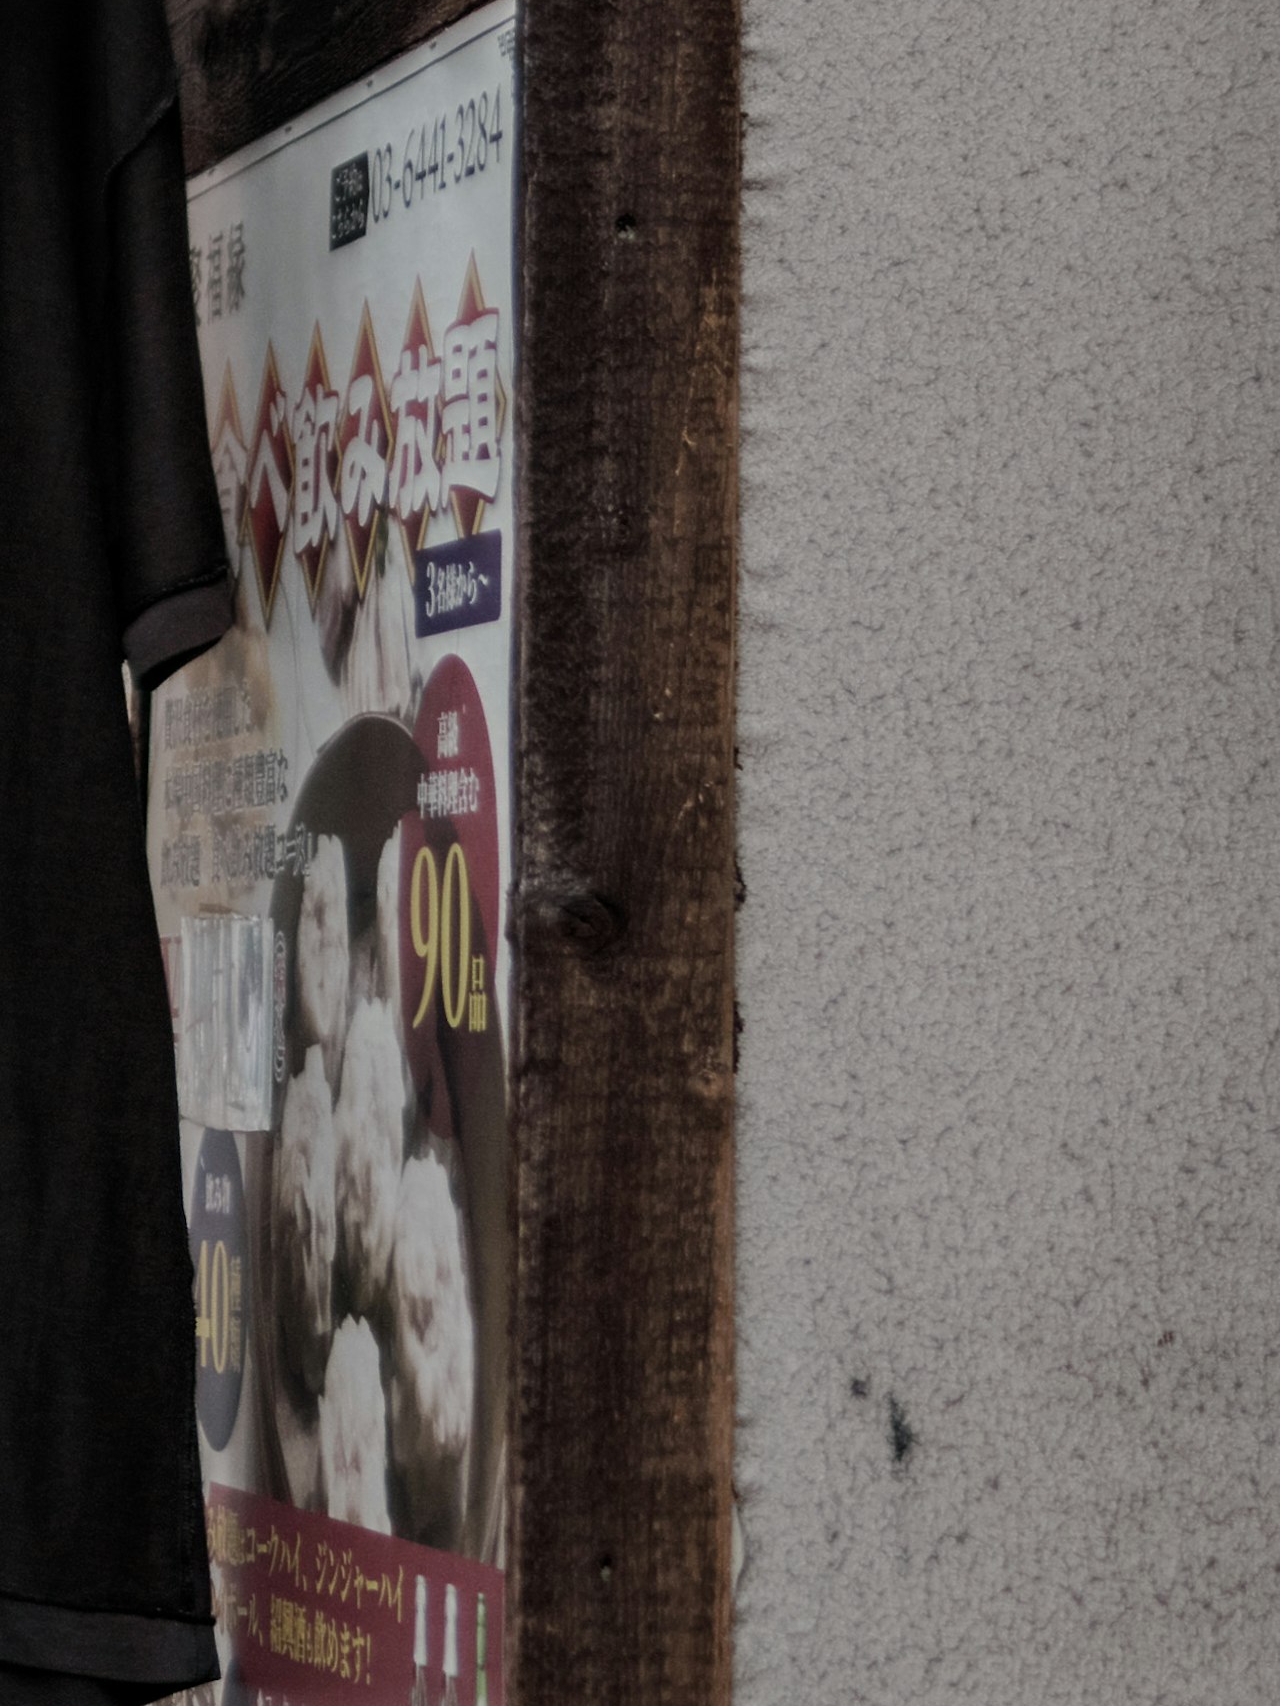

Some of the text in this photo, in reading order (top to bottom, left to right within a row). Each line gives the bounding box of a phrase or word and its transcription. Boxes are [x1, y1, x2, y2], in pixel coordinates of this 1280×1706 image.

[372, 83, 503, 223] 03-6441-3284
[213, 309, 501, 574] 食べ飲み放題
[417, 767, 480, 818] 中華料理含む
[437, 712, 458, 758] 高級
[410, 841, 487, 1034] 90品
